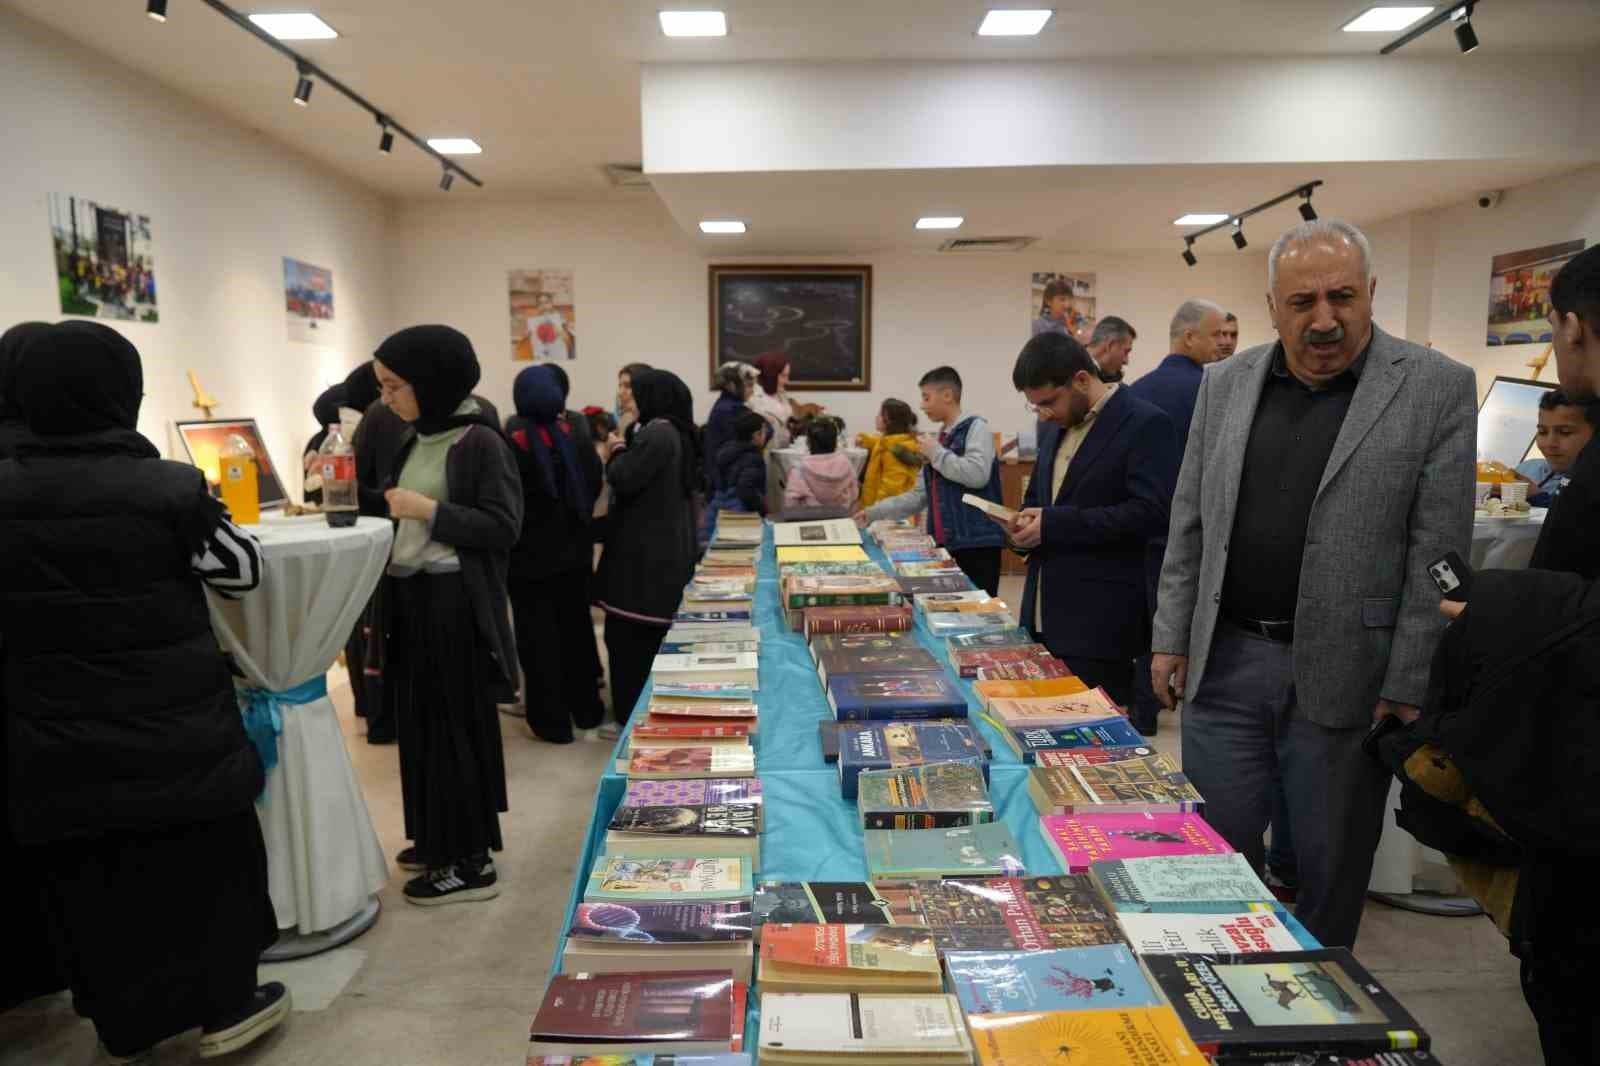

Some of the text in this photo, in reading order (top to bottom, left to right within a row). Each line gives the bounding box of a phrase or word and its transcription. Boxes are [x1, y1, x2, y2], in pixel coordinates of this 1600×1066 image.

[858, 730, 876, 757] ANKARA
[996, 880, 1024, 916] Pamuk
[1015, 919, 1041, 950] Orhan
[1193, 960, 1218, 984] ÖZEL
[1184, 991, 1211, 1019] CUMA
